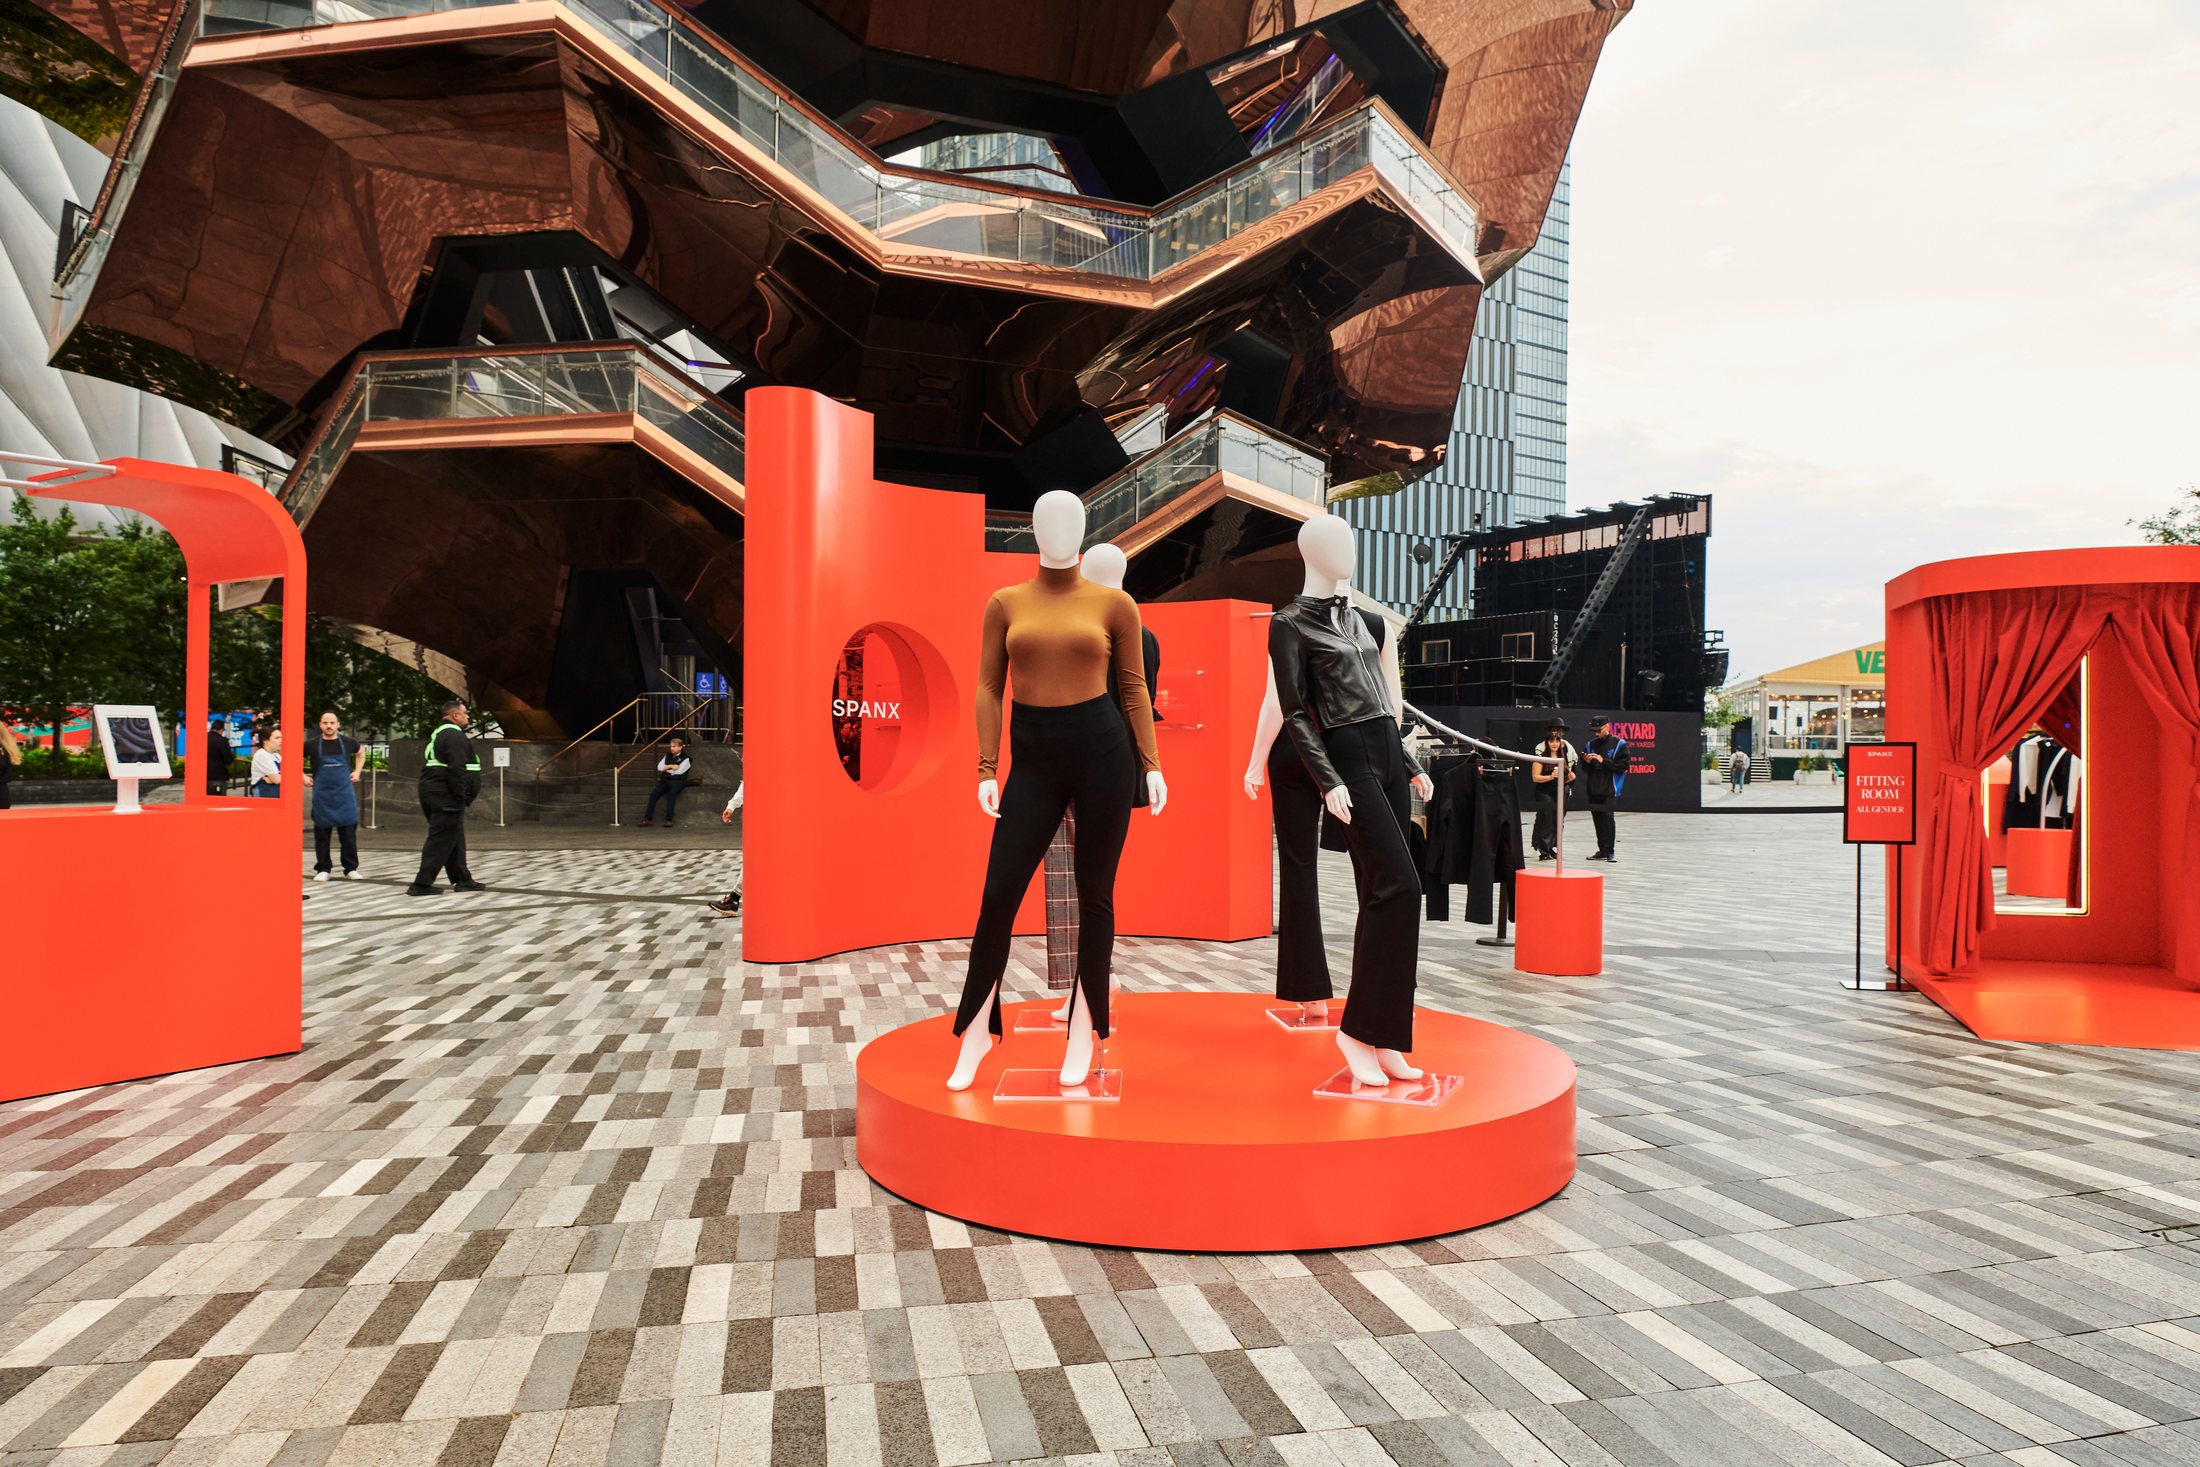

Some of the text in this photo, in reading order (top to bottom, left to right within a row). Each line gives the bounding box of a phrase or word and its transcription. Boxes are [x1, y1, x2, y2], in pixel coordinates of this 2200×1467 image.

[832, 699, 901, 719] SPANX
[1608, 722, 1656, 740] ACKYARD
[1629, 764, 1656, 773] FARGO
[1856, 775, 1905, 786] FITTING
[1861, 788, 1900, 800] ROOM
[1856, 805, 1905, 813] ALL GENDER
